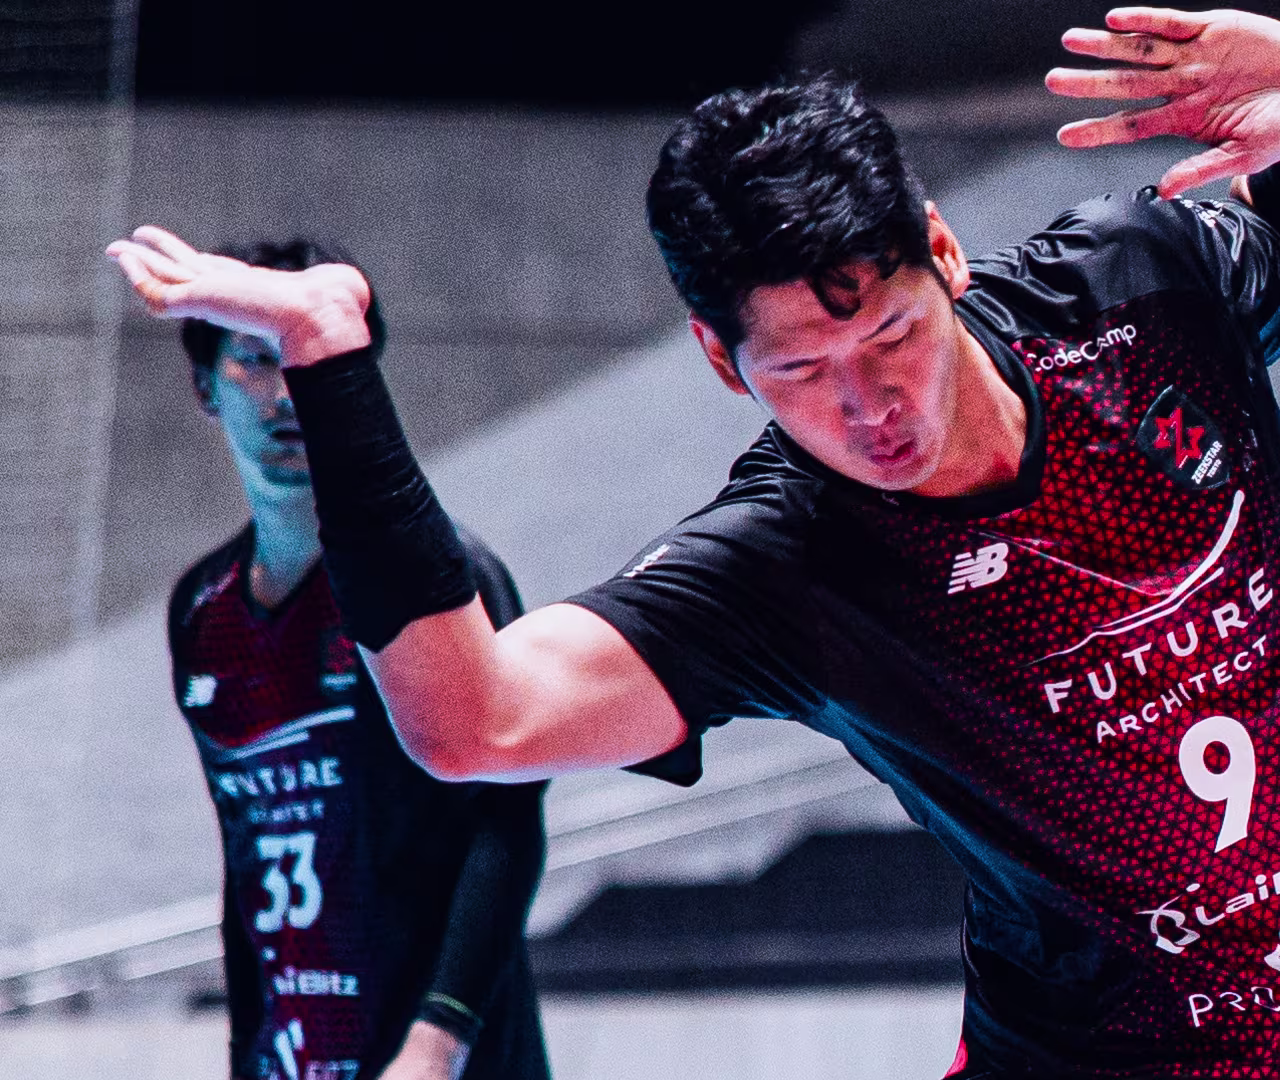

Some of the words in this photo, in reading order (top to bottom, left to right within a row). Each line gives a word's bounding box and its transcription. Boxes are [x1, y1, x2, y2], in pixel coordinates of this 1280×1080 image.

[1191, 440, 1223, 485] ZEEKSTAR
[948, 543, 1009, 594] NB
[1043, 567, 1274, 713] FUTURE
[1097, 635, 1267, 743] ARCHITECT
[1178, 716, 1256, 853] 9
[254, 832, 323, 933] 33
